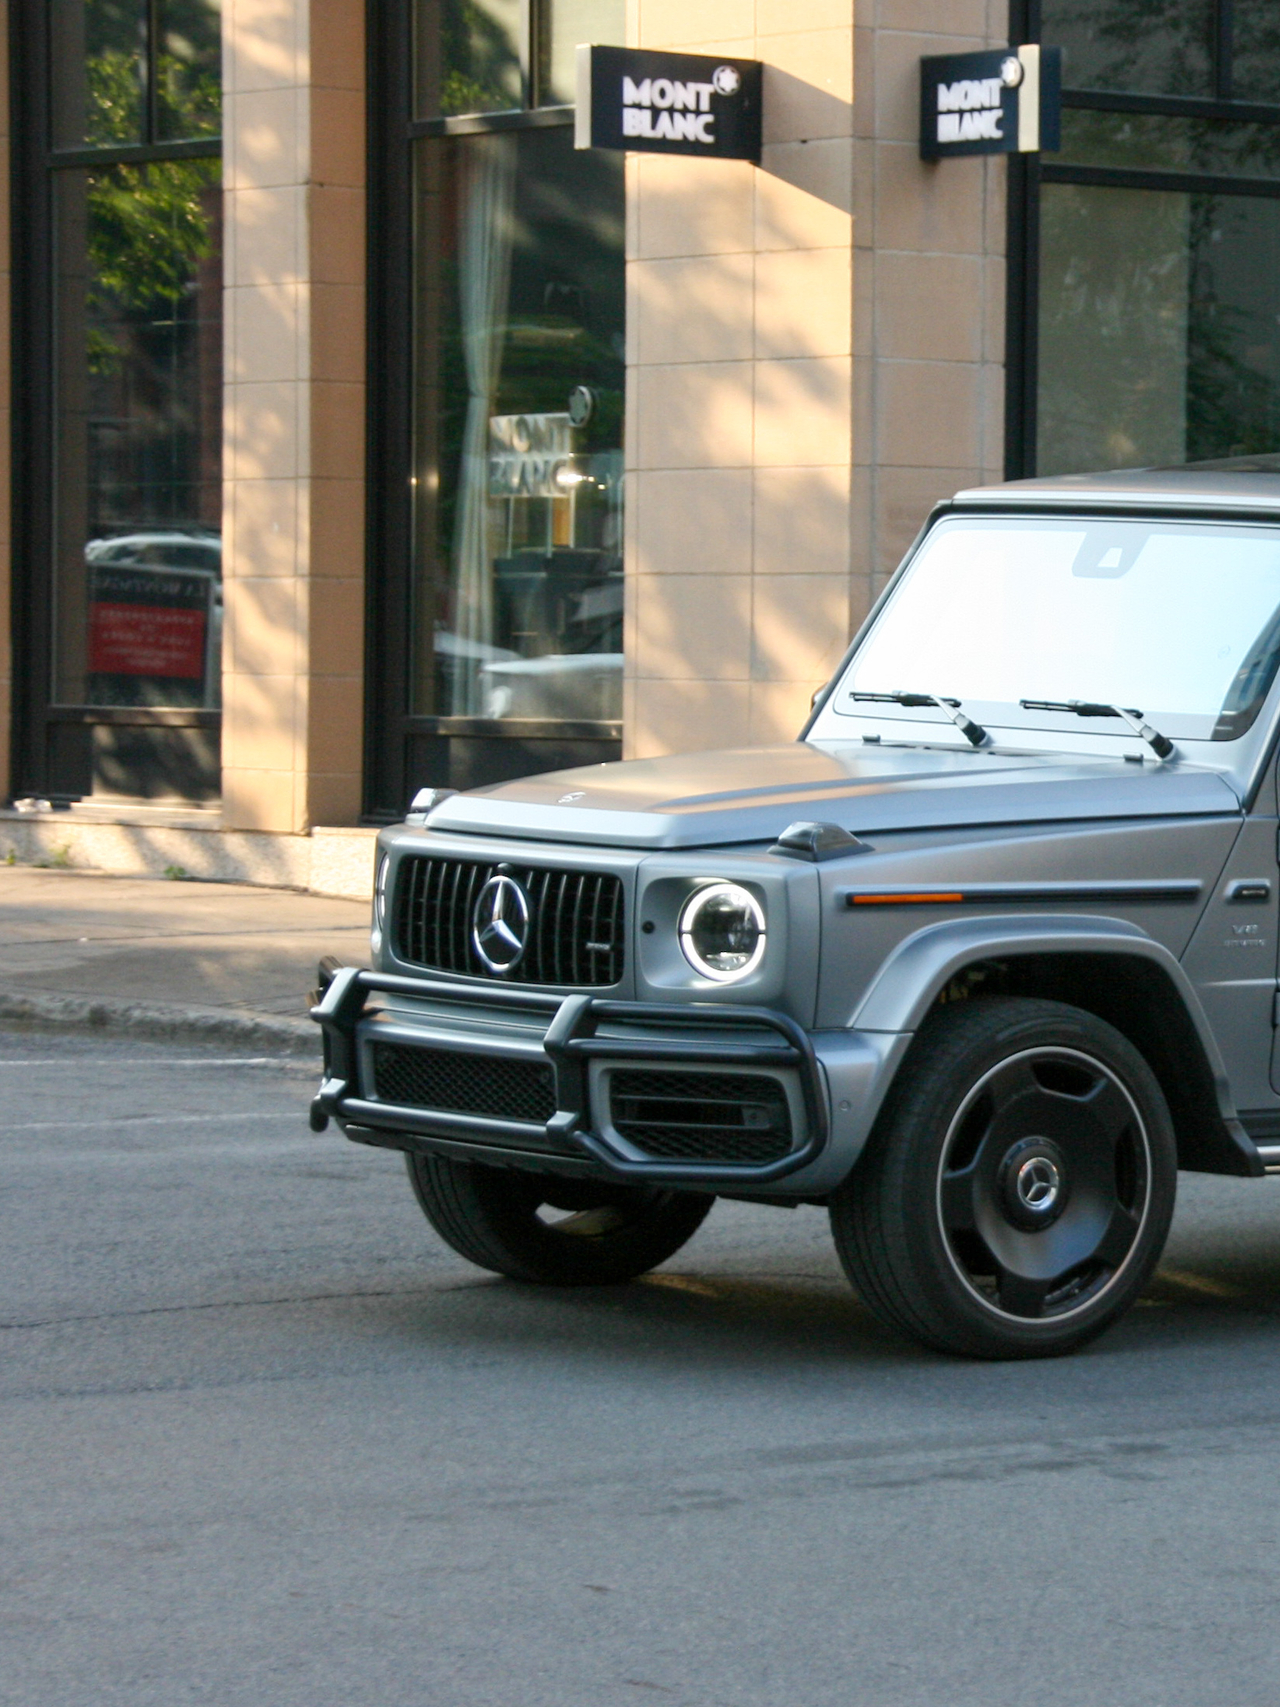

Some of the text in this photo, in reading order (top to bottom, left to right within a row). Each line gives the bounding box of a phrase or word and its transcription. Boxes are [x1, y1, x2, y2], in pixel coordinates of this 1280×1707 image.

[622, 76, 717, 110] MONT
[937, 77, 1002, 112] MONT
[622, 107, 716, 143] BLANC
[937, 108, 1003, 143] BLANC
